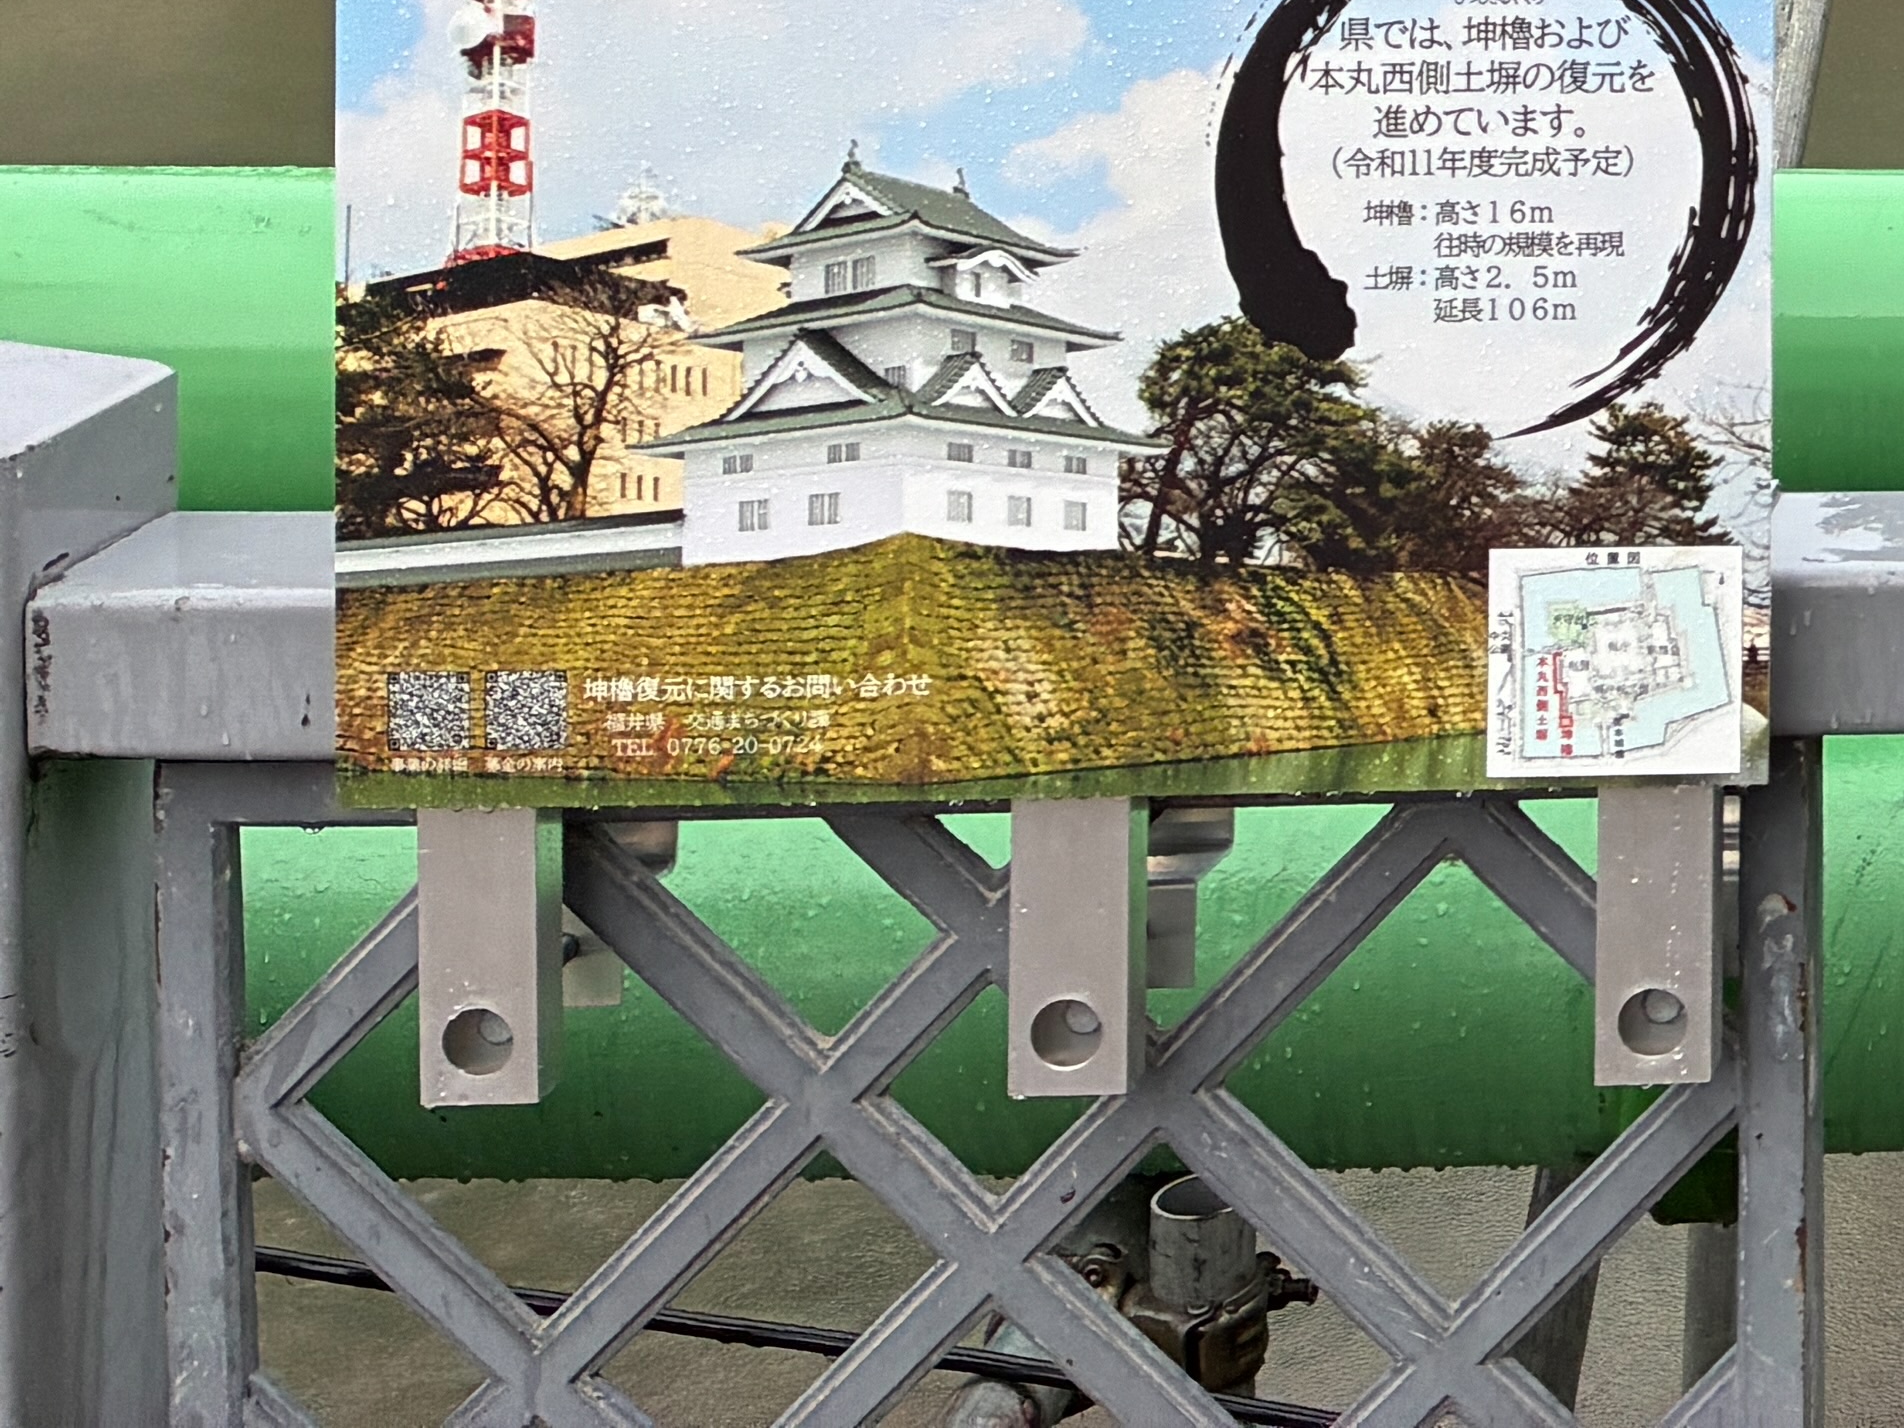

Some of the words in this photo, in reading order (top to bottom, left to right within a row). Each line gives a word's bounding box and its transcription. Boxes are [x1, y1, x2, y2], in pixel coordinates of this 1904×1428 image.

[1340, 15, 1631, 52] 県では、坤櫓および
[1309, 60, 1655, 95] 本丸西側土塀の復元を
[1373, 104, 1586, 139] 進めています。
[1434, 231, 1625, 258] 往時の規模を再現
[583, 673, 933, 701] 坤櫓復元に関するお問い合わせ
[612, 737, 655, 757] TEL
